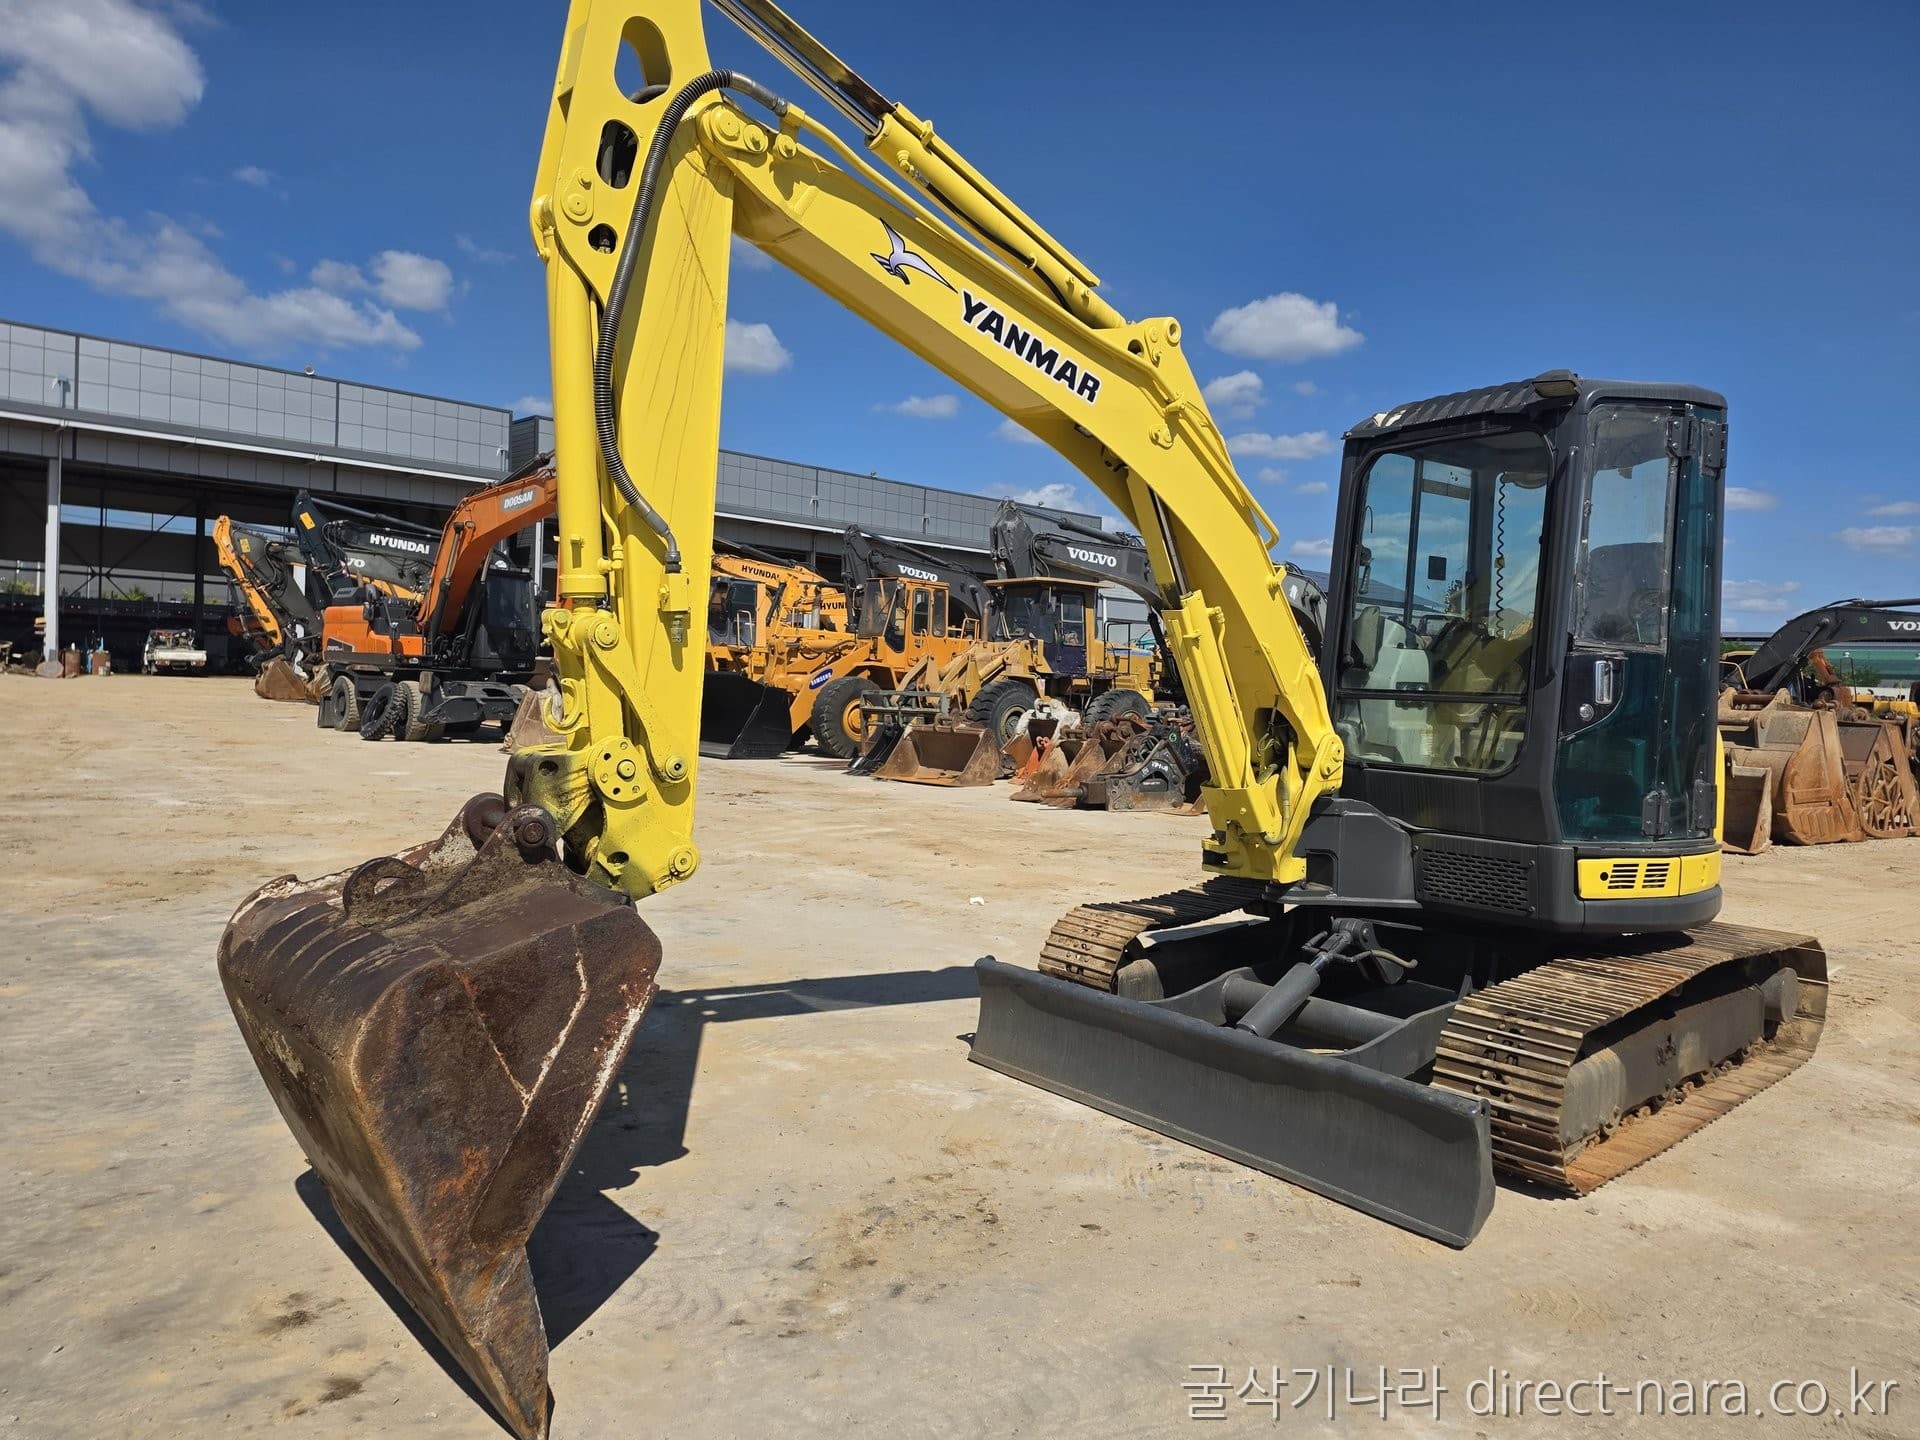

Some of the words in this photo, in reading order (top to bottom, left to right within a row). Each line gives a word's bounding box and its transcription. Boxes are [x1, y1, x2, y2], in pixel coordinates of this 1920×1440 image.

[963, 290, 1101, 403] YANMAR
[504, 490, 533, 509] DOOSAN
[370, 534, 430, 554] HYUNDAI
[1067, 546, 1117, 567] VOLVO
[897, 564, 938, 582] VOLVO
[820, 602, 847, 610] HYUN
